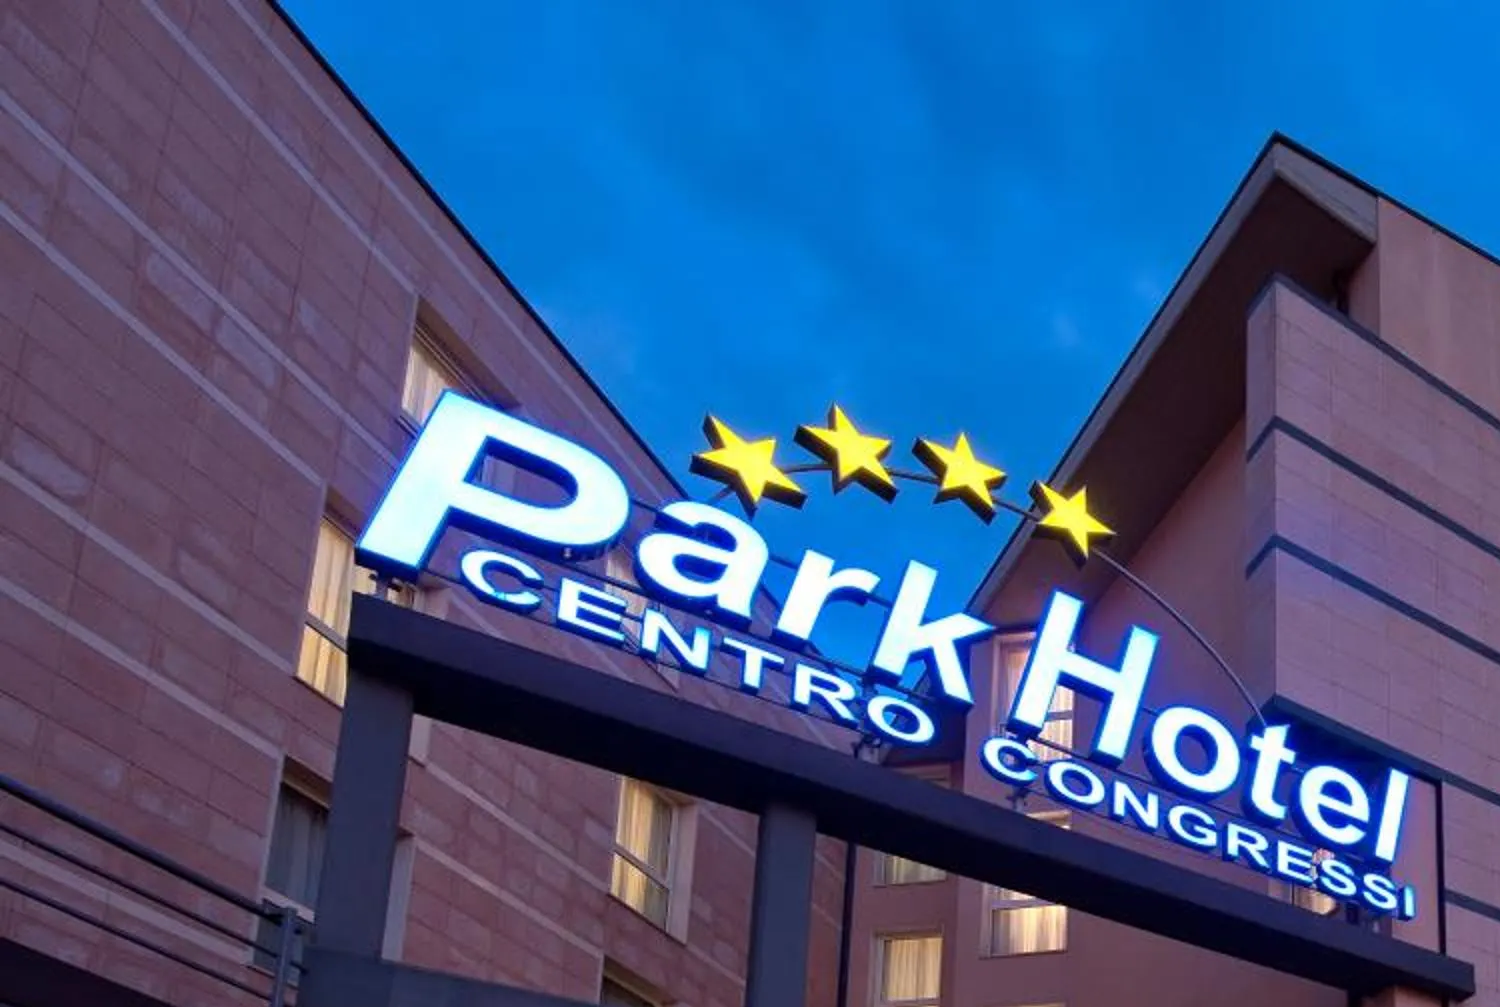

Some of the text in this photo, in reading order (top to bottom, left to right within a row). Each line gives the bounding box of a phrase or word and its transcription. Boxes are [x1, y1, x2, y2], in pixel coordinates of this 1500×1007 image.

[355, 388, 1411, 864] Park Hotel
[459, 548, 1416, 920] CENTRO CONGRESSI
